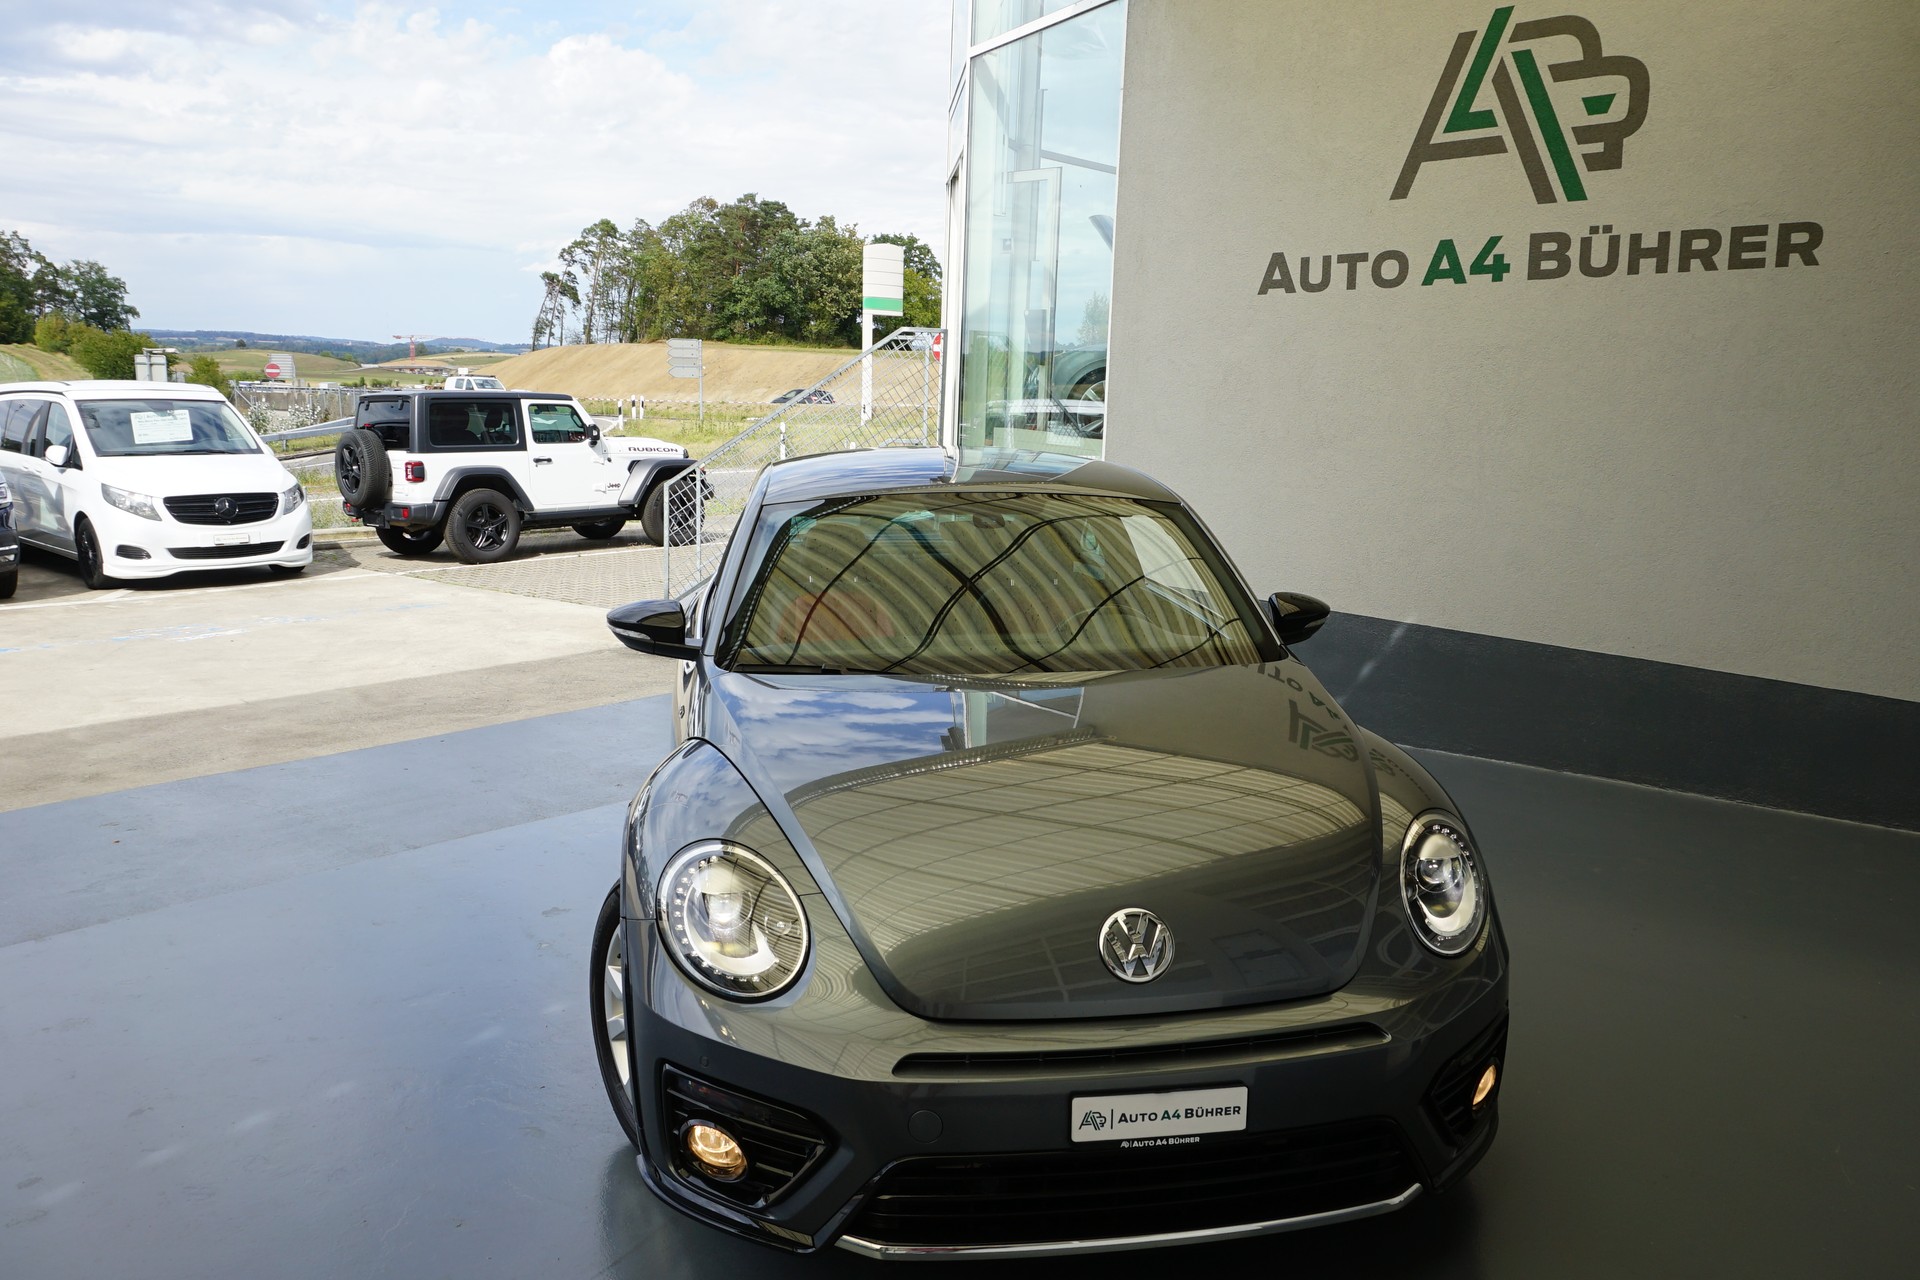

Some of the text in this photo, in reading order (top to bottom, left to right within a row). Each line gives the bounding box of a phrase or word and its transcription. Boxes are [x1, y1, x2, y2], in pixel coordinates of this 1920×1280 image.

[1257, 220, 1825, 296] AUTO A4 BÜHRER
[1117, 1105, 1242, 1124] AUTO A4 BÜHRER
[1132, 1136, 1201, 1148] AUTO A4 BÜHRER
